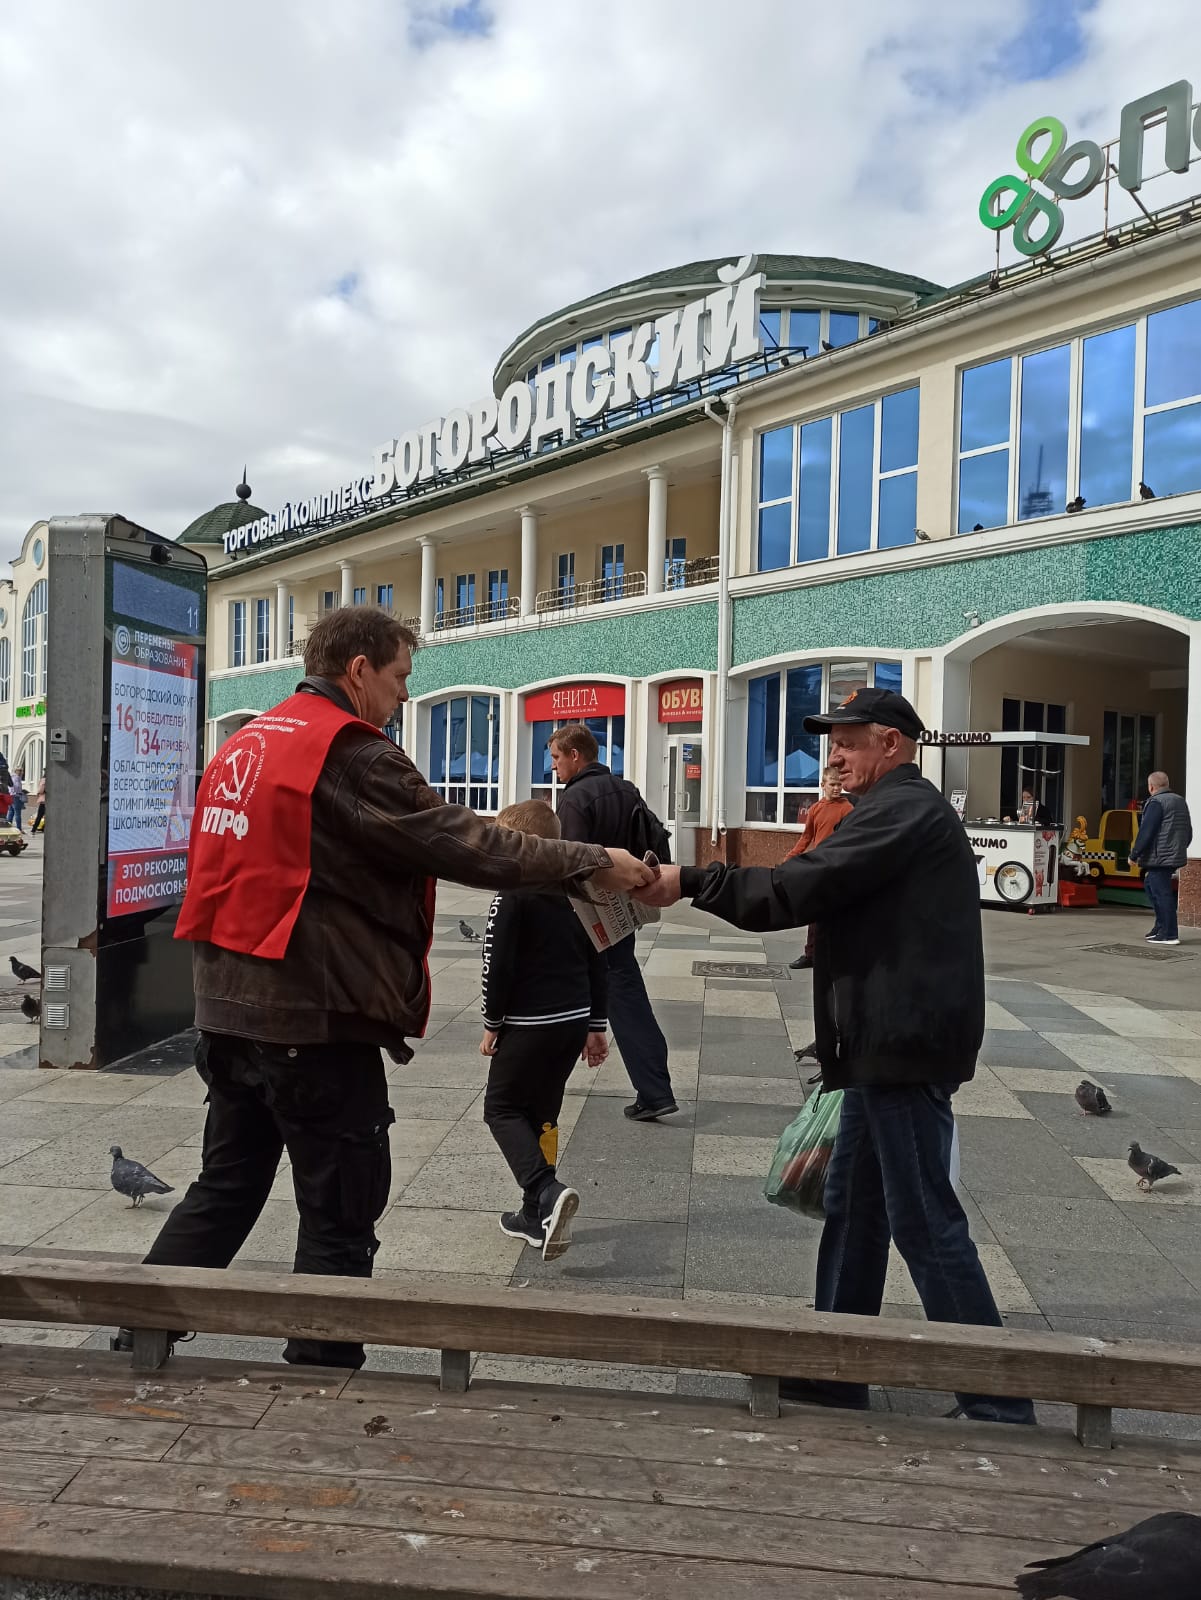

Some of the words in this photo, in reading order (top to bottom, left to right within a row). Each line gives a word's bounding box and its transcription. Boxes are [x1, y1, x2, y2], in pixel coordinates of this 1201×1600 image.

[1119, 79, 1201, 192] П
[222, 502, 292, 554] ТОРГОВЫЙ
[291, 476, 375, 529] КОМПЛЕКС
[372, 254, 766, 498] БОГОРОДСКИЙ
[134, 630, 175, 651] ПЕРЕМЕНЫ:
[134, 645, 188, 669] ОБРАЗОВАНИЕ
[114, 683, 172, 703] БОГОРОДСКИЙ
[552, 688, 599, 708] ЯНИТА
[661, 688, 703, 709] ОБУВ
[116, 703, 134, 733] 16
[135, 710, 187, 728] ПОБЕДИТЕЛЕЙ
[134, 727, 161, 756] 134
[113, 759, 165, 774] ОБЛАСТНОГО
[113, 777, 179, 792] ВСЕРОССИЙСКОЙ
[113, 798, 166, 814] ОЛИМПИАДЫ
[112, 815, 168, 831] ШКОЛЬНИКОВ
[121, 863, 143, 880] ЭТО
[144, 857, 187, 877] РЕКОРДЫ
